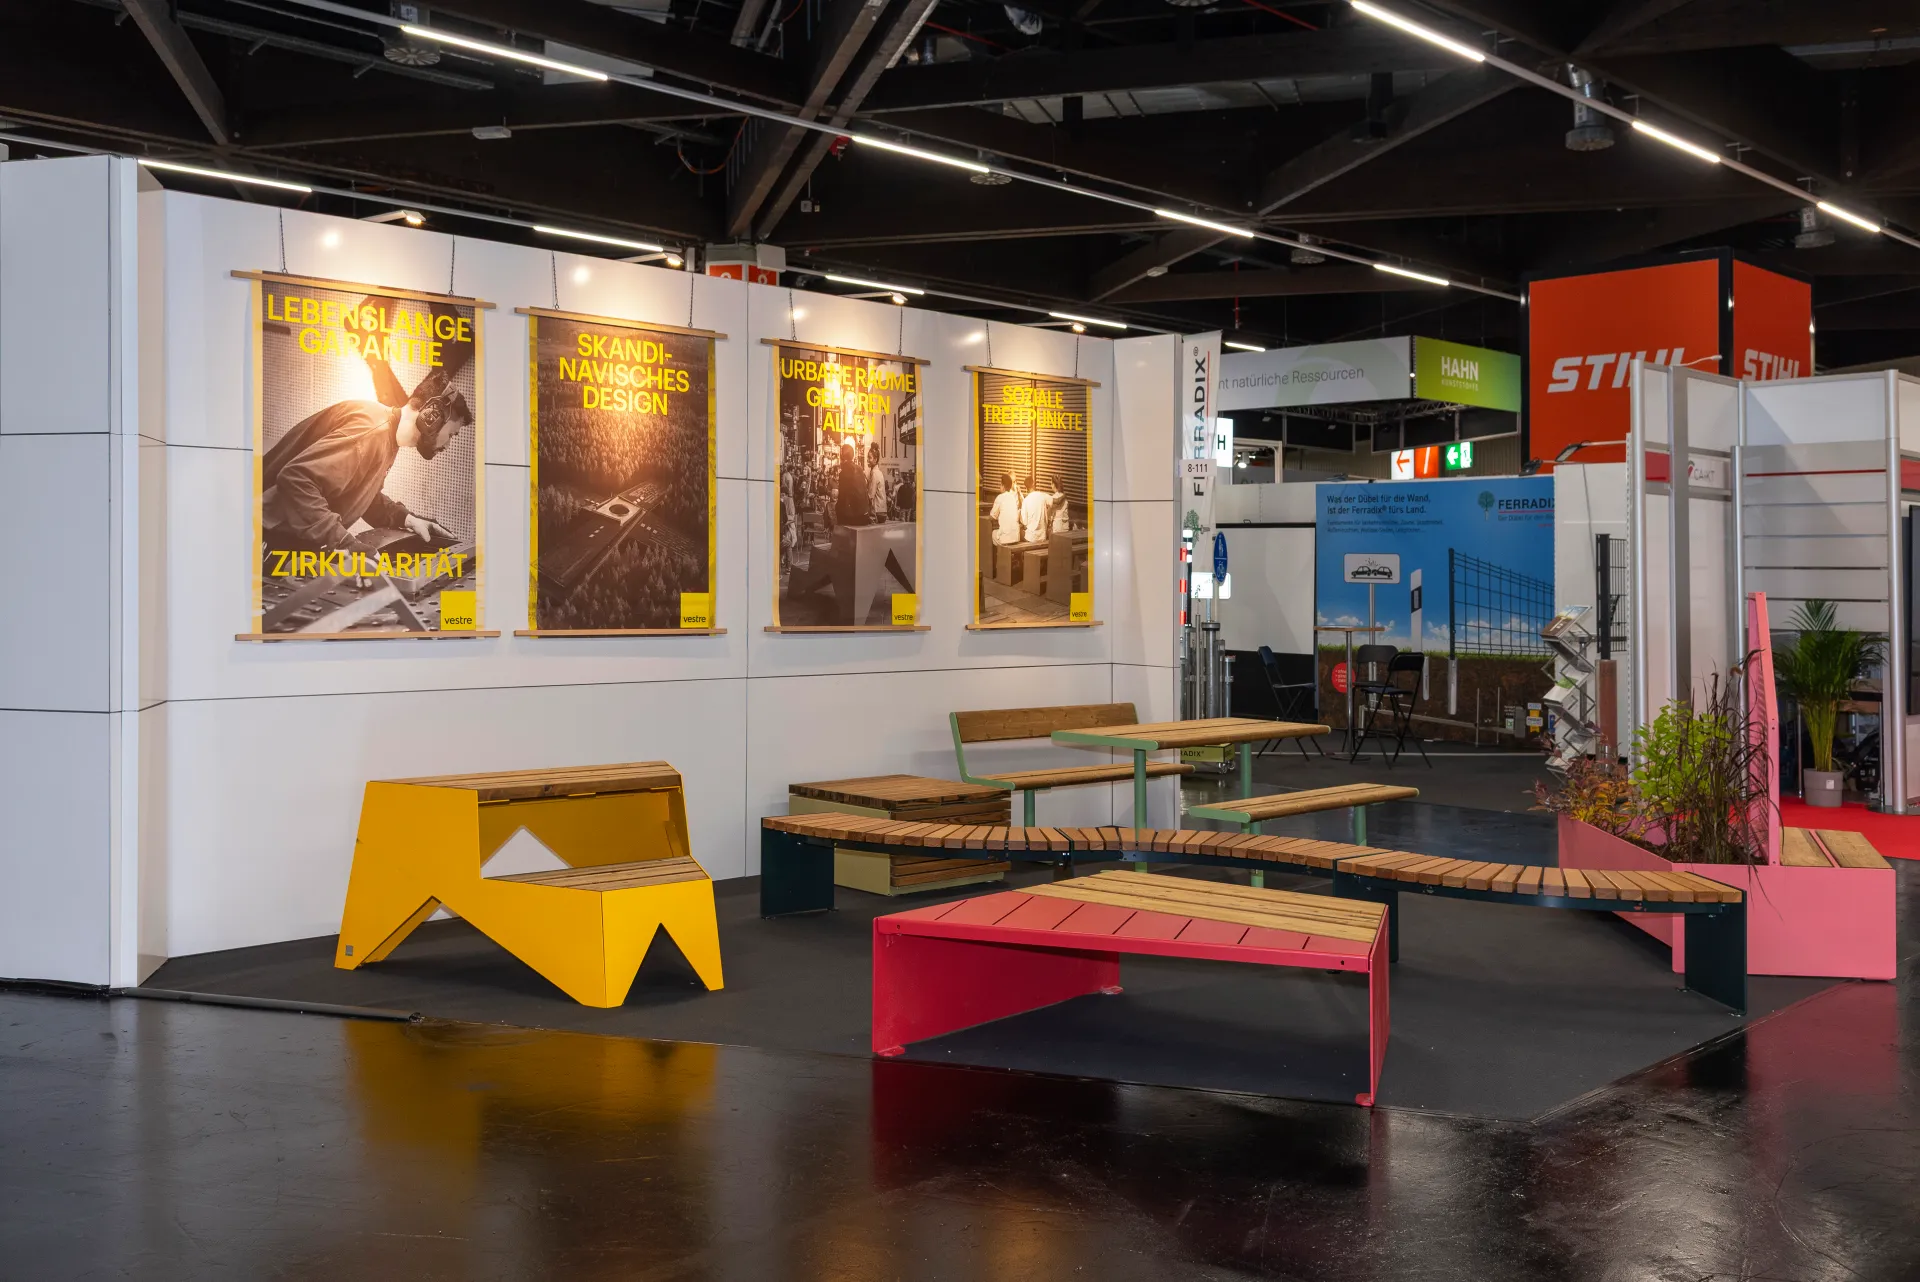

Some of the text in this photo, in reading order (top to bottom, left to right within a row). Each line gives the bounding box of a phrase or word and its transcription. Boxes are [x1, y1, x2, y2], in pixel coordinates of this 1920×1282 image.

[268, 294, 471, 342] LEBENSLANGE
[299, 328, 443, 367] GARANTIE
[577, 333, 672, 365] SKANDI-
[559, 356, 690, 393] NAVISCHES
[780, 357, 916, 393] URBANE RÄUME
[1232, 372, 1289, 388] natürliche
[1292, 368, 1365, 384] Ressourcen
[1441, 355, 1479, 381] HAHN
[1547, 347, 1685, 393] STI
[583, 385, 668, 416] DESIGN
[806, 386, 891, 414] GEHÖREN
[1002, 385, 1064, 410] SOZIALE
[822, 411, 876, 435] ALLEN
[982, 403, 1084, 431] TREFFPUNKTE
[1187, 463, 1208, 473] 8-111
[1327, 493, 1431, 504] Was der Dübel für die Wand,
[1327, 506, 1336, 514] ist
[1338, 506, 1349, 514] der
[1388, 505, 1404, 514] fürs
[1406, 505, 1427, 514] Land.
[271, 547, 468, 578] ZIRKULARITÄT
[444, 615, 473, 625] vestre
[683, 615, 707, 623] vestre
[894, 613, 914, 621] vestre
